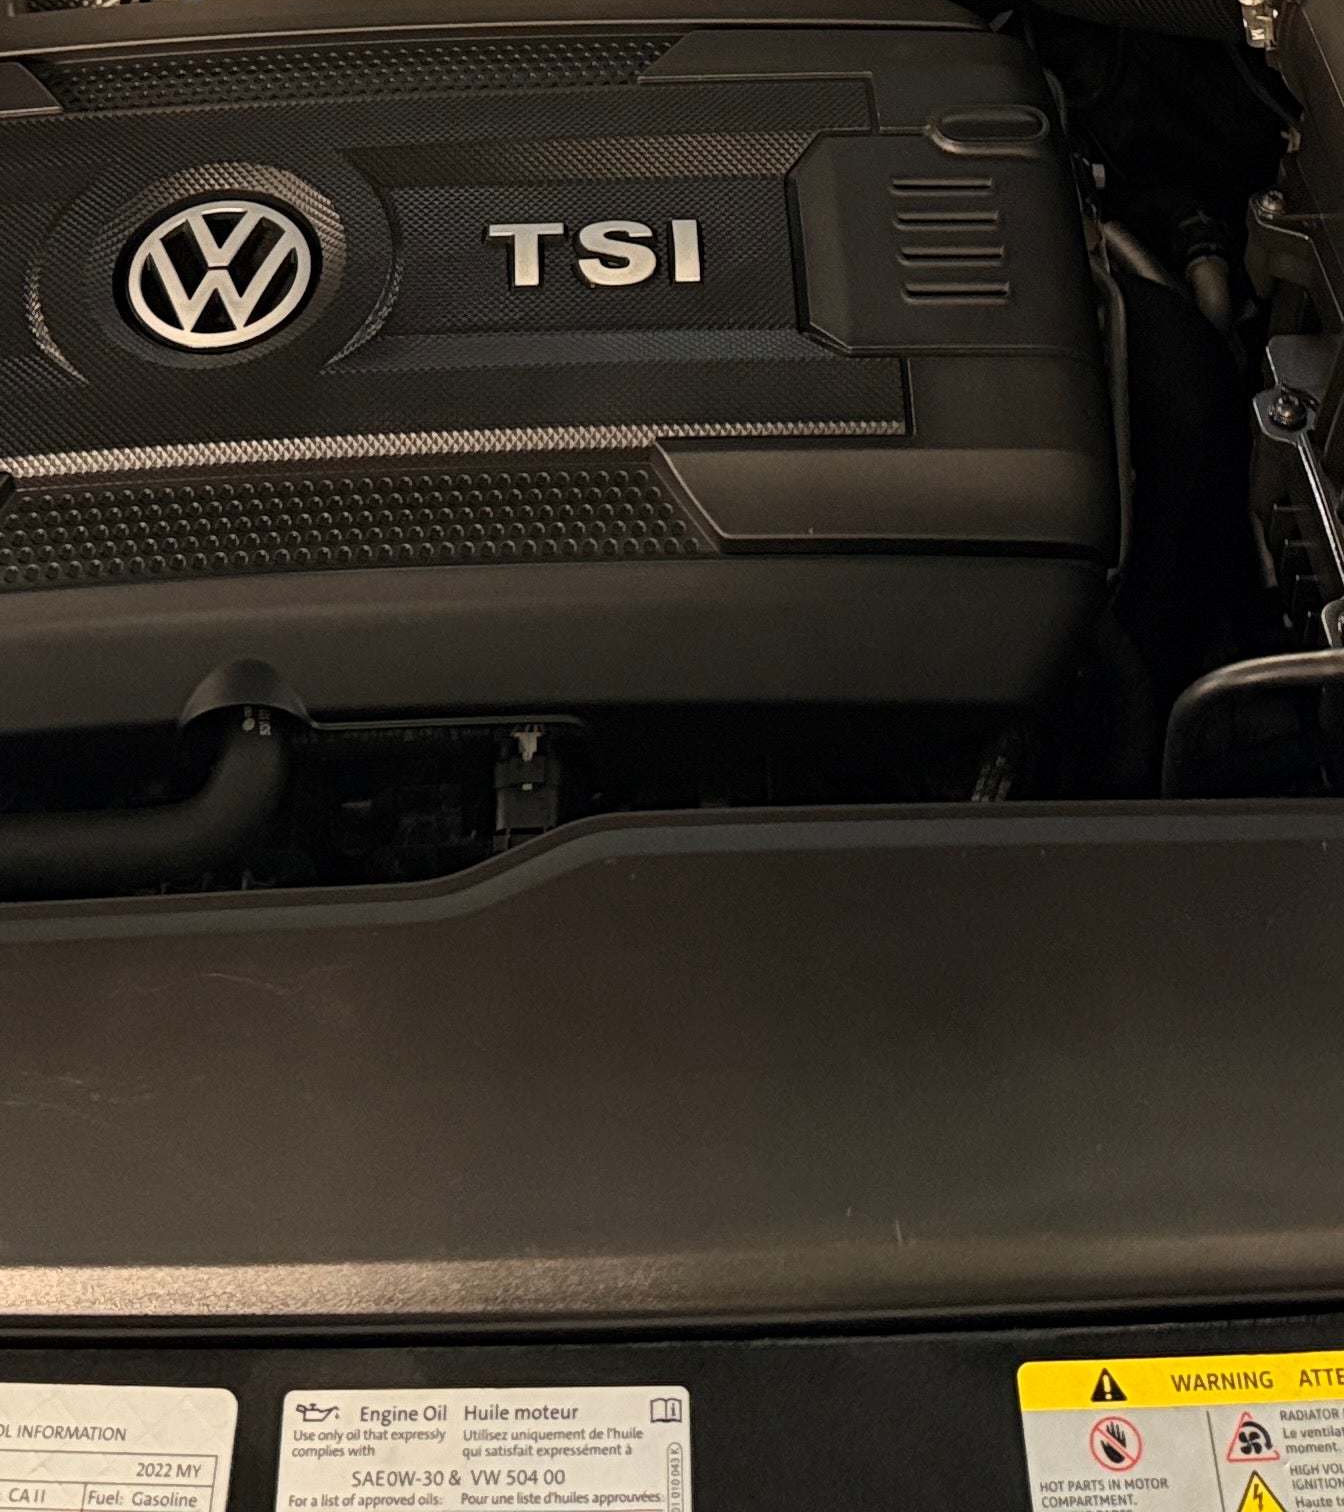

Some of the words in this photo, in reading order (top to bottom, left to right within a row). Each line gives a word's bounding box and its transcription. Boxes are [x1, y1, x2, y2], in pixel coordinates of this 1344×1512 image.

[489, 219, 705, 288] TSI
[1169, 1370, 1274, 1393] WARNING
[359, 1405, 419, 1424] Engine
[422, 1404, 448, 1422] Oil
[464, 1403, 510, 1422] Huile
[514, 1404, 579, 1421] moteur
[1279, 1407, 1340, 1422] RADIATOR
[16, 1424, 127, 1442] INFORMATION
[293, 1429, 317, 1442] Use
[317, 1428, 345, 1445] only
[345, 1428, 362, 1442] oil
[362, 1428, 389, 1441] that
[390, 1427, 447, 1444] expressly
[463, 1428, 509, 1442] Utilisez
[510, 1427, 586, 1444] uniquement
[588, 1426, 605, 1441] de
[606, 1426, 644, 1440] l'huile
[1282, 1427, 1298, 1440] Le
[291, 1443, 346, 1459] complies
[347, 1443, 376, 1457] with
[461, 1445, 483, 1459] qui
[484, 1443, 534, 1458] satisfait
[534, 1442, 623, 1458] expressément
[624, 1442, 633, 1456] à
[135, 1461, 173, 1479] 2022
[175, 1463, 202, 1479] MY
[1285, 1461, 1321, 1477] HIGH
[351, 1469, 445, 1489] SAE0W-30
[447, 1469, 462, 1487] &
[469, 1469, 502, 1487] VW
[505, 1469, 539, 1487] 504
[543, 1468, 566, 1486] 00
[1039, 1479, 1065, 1494] HOT
[1067, 1478, 1106, 1493] PARTS
[1107, 1478, 1122, 1492] IN
[1123, 1476, 1170, 1491] MOTOR
[8, 1487, 31, 1504] CA
[87, 1489, 124, 1506] Fuel:
[131, 1491, 199, 1509] Gasoline
[288, 1494, 309, 1508] For
[310, 1496, 319, 1509] a
[320, 1493, 340, 1508] list
[341, 1492, 357, 1508] of
[357, 1492, 416, 1509] approved
[417, 1492, 443, 1507] oils:
[460, 1492, 490, 1506] Pour
[490, 1494, 515, 1506] une
[516, 1491, 542, 1505] liste
[543, 1490, 590, 1505] d'huiles
[1041, 1493, 1138, 1509] COMPARTMENT.
[1294, 1495, 1334, 1510] Haute
